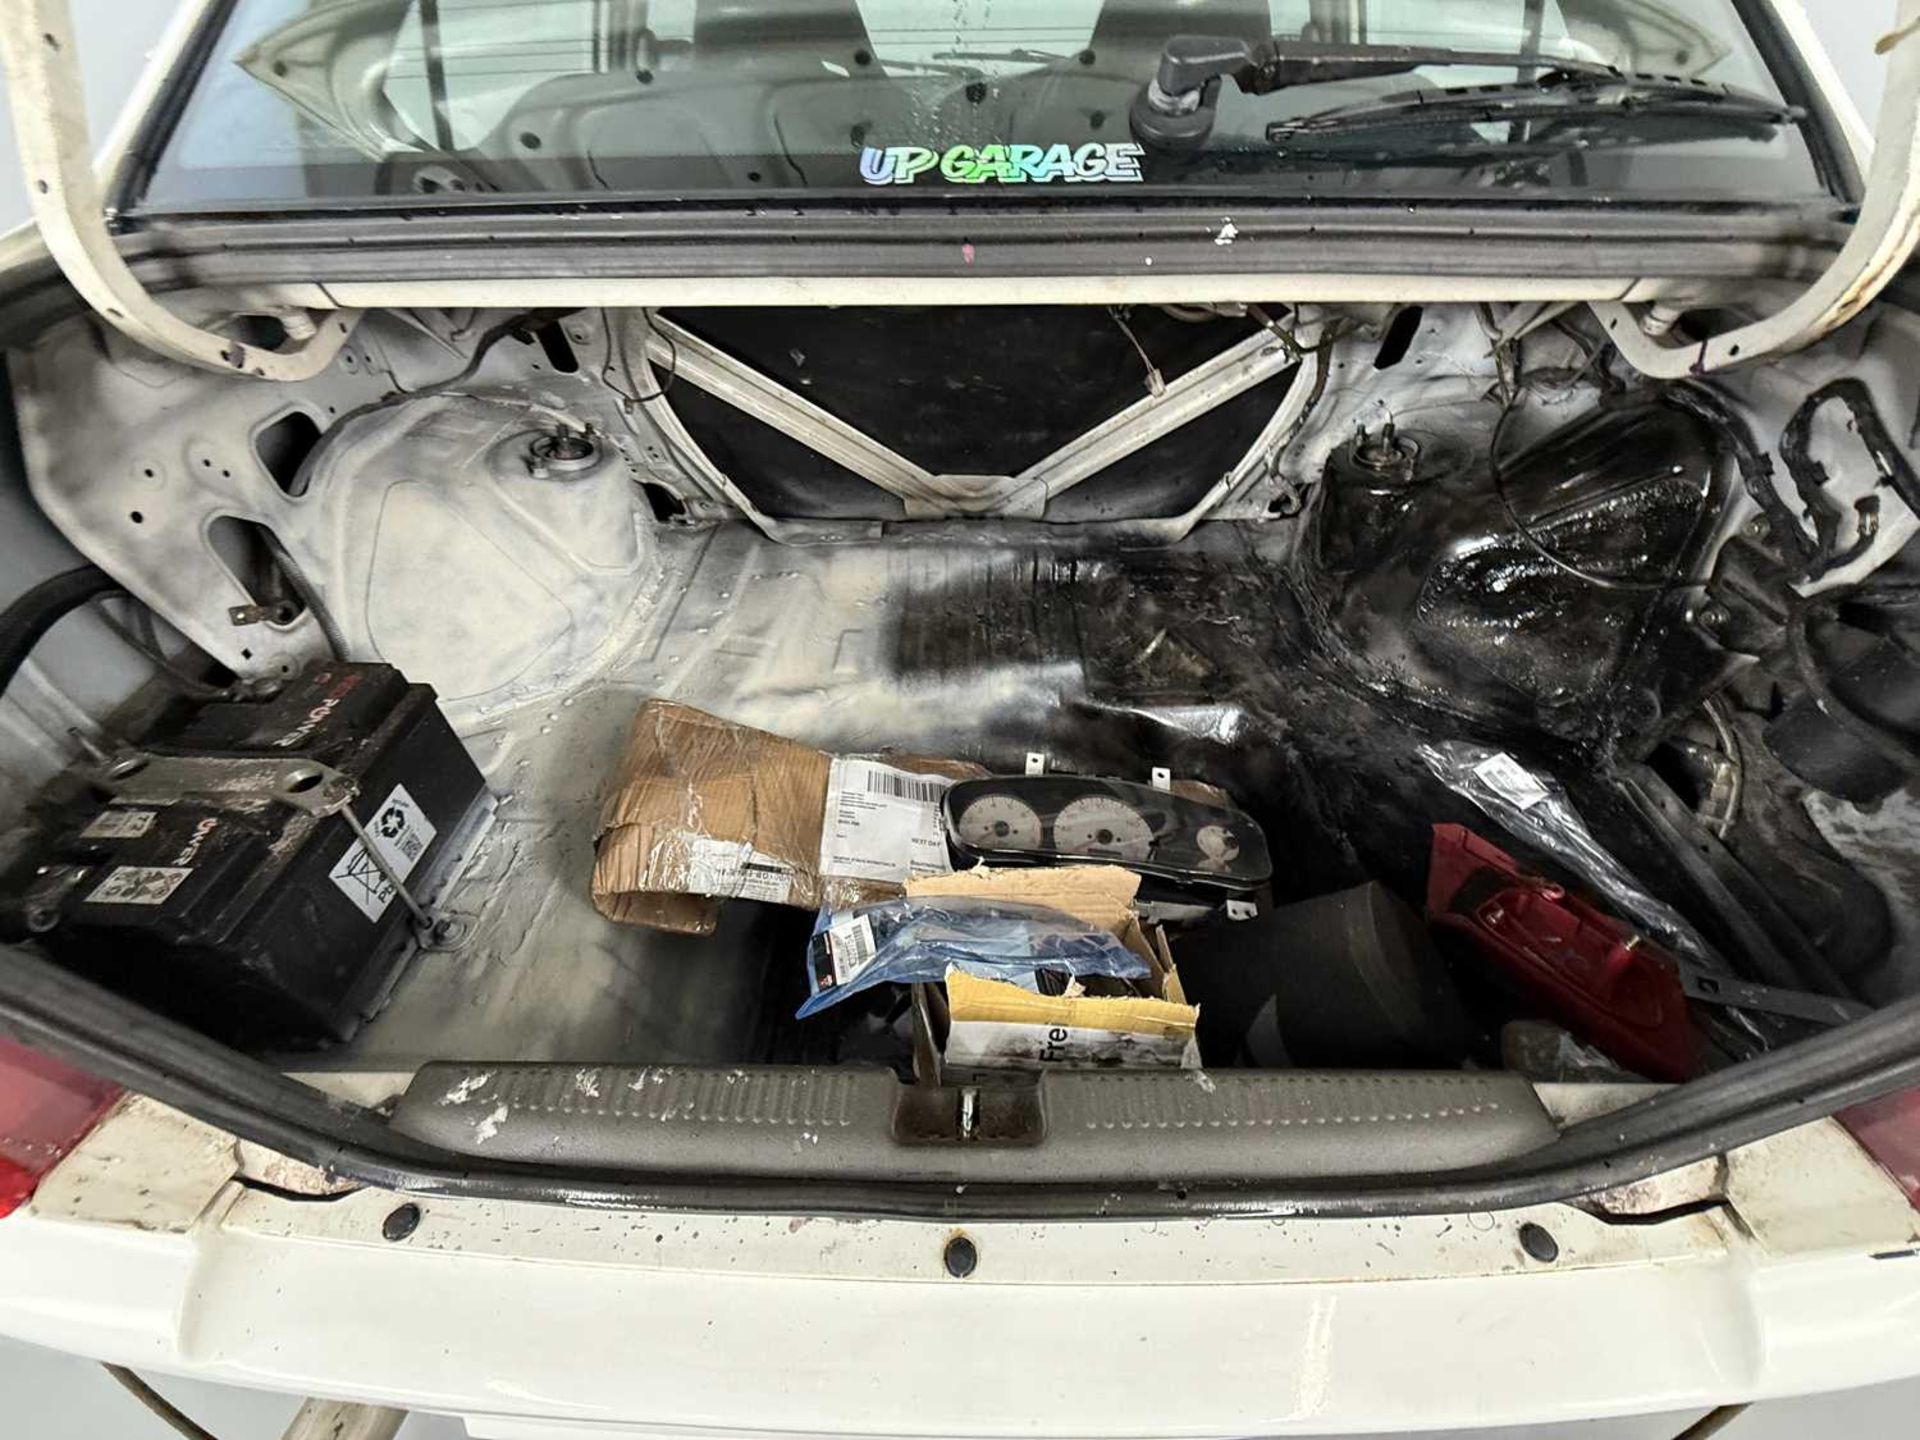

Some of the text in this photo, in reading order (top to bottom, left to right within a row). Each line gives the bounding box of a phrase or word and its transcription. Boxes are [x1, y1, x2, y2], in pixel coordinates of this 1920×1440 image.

[860, 142, 1146, 186] UP GARAGE
[377, 884, 395, 904] Pb
[1039, 1022, 1068, 1062] Fre
